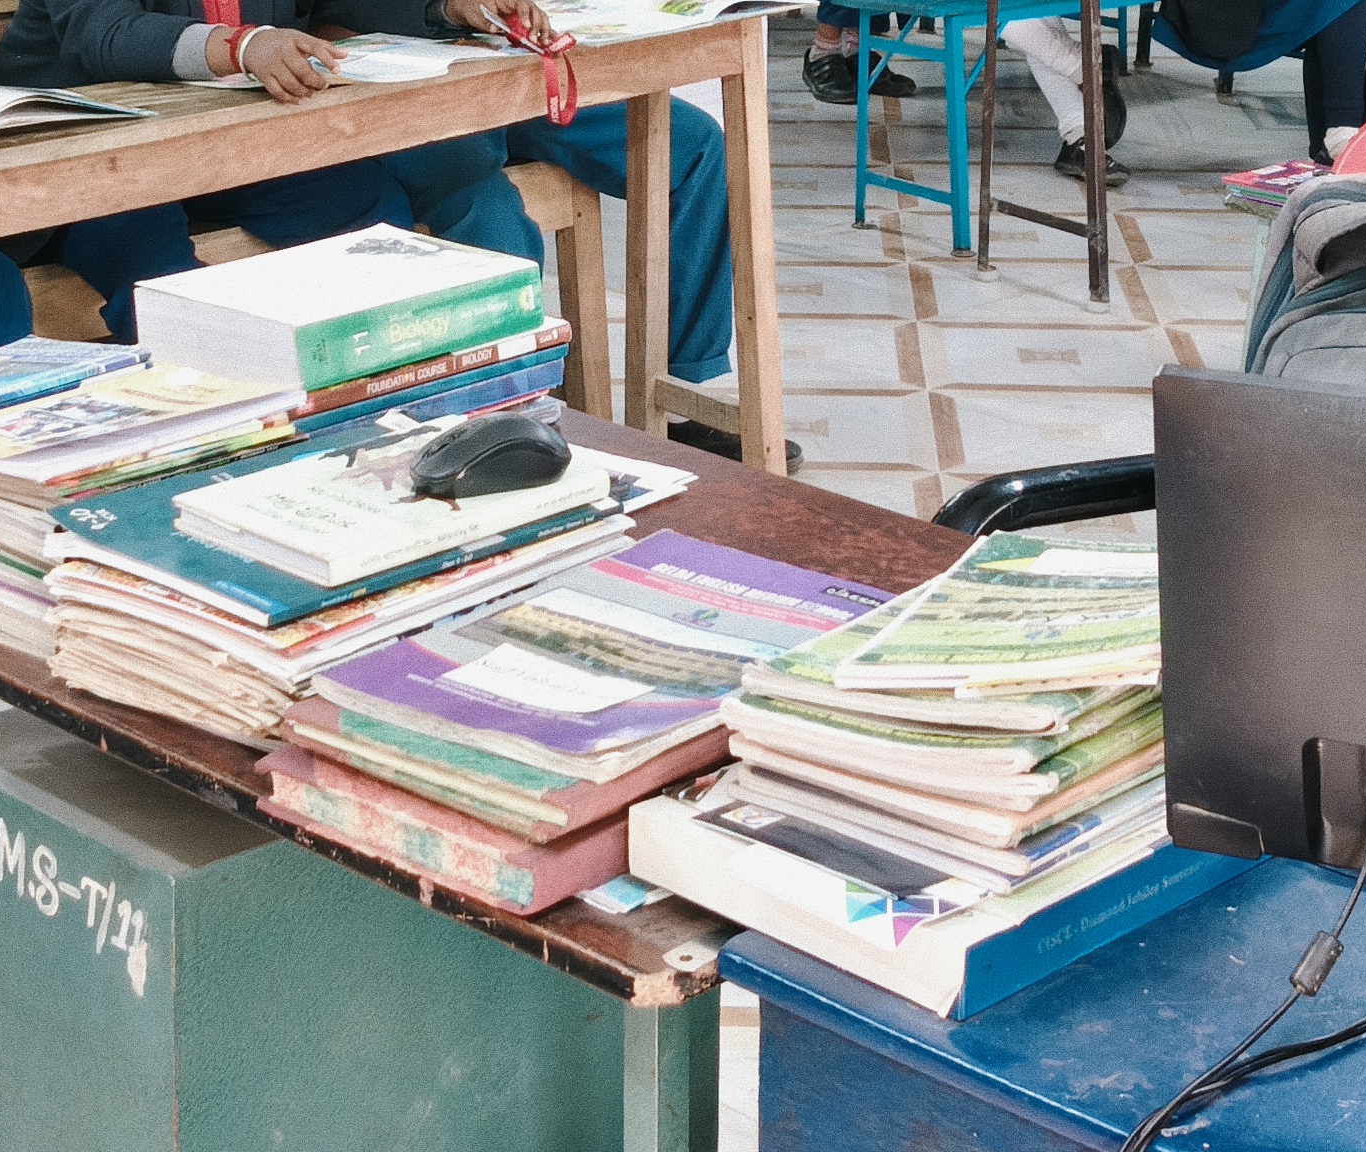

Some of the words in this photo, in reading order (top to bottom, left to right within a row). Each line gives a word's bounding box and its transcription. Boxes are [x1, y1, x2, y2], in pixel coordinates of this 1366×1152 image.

[388, 317, 451, 345] Biology
[417, 361, 448, 381] COURSE
[462, 348, 493, 368] BIOLOGY
